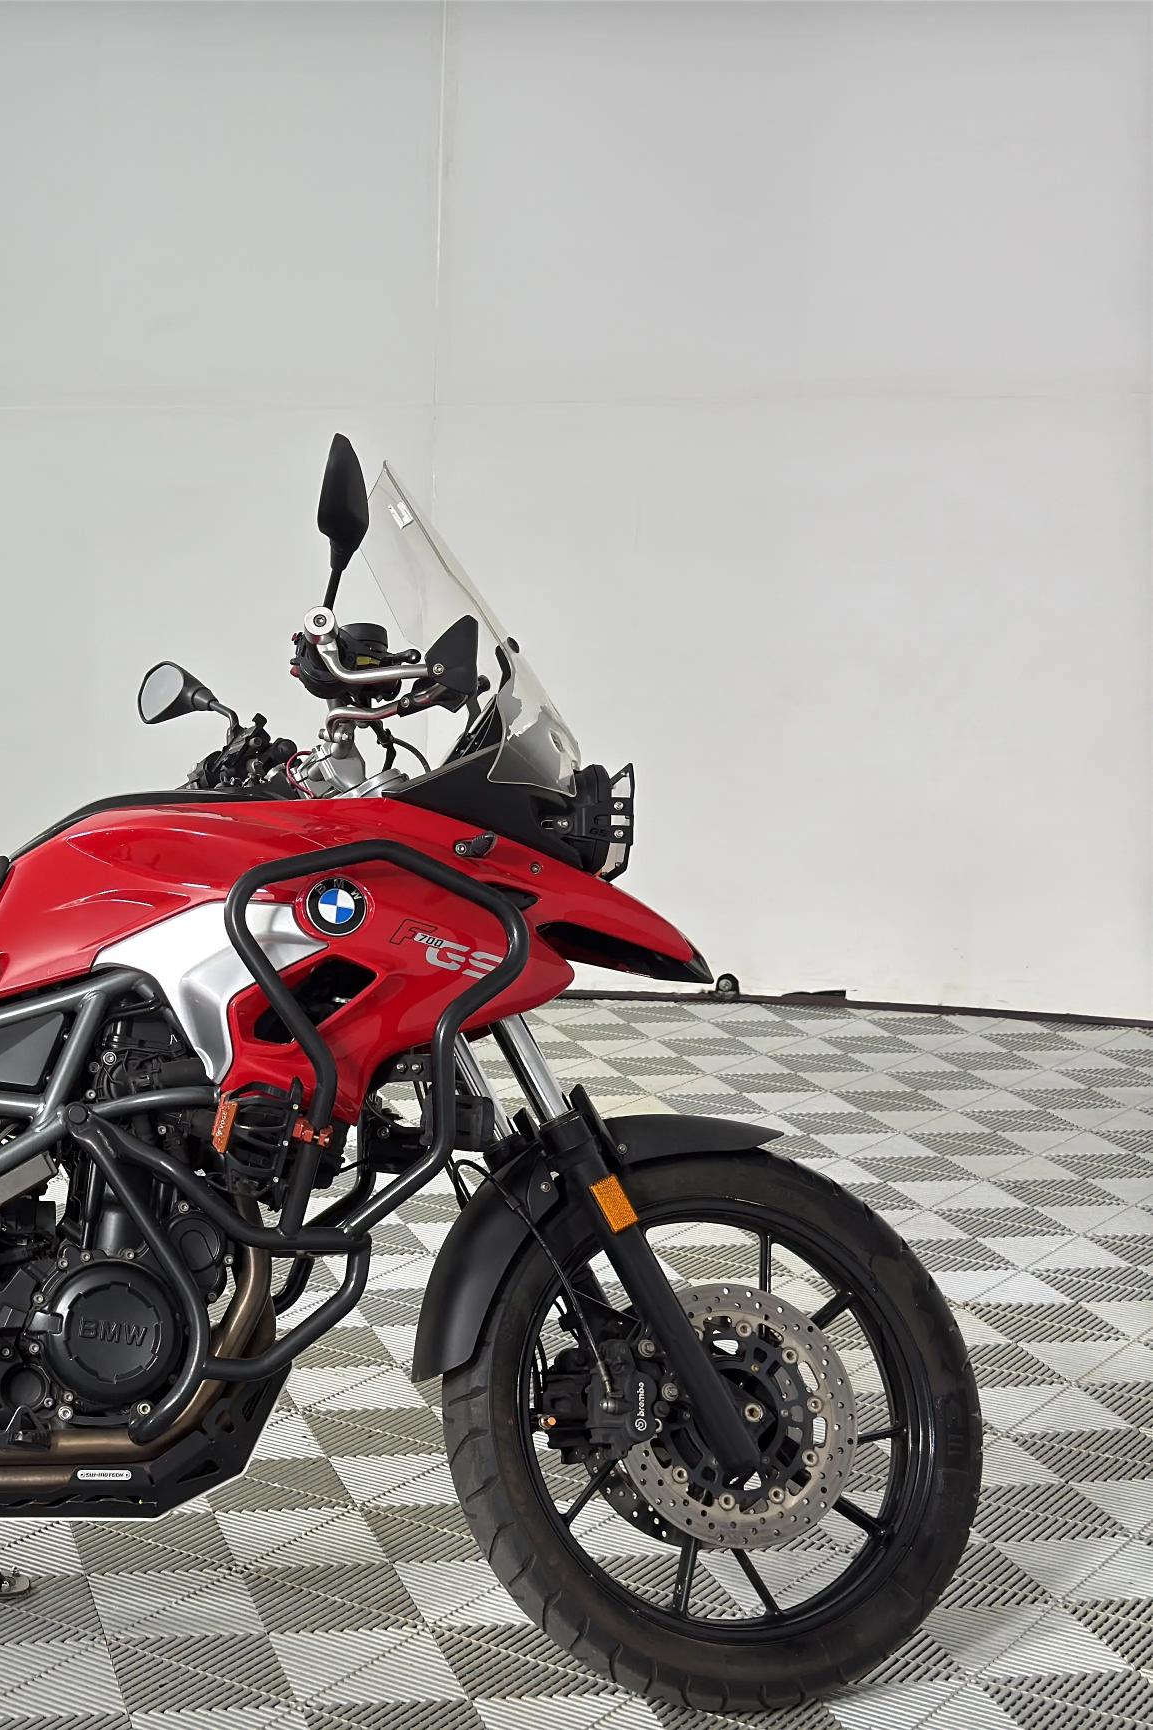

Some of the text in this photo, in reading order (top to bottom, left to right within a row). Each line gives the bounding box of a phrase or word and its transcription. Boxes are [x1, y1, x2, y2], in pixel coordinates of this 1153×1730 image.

[314, 878, 363, 901] BMW
[390, 918, 439, 945] F
[418, 934, 445, 949] 700
[78, 1316, 148, 1346] BMW
[636, 1382, 645, 1417] brembo
